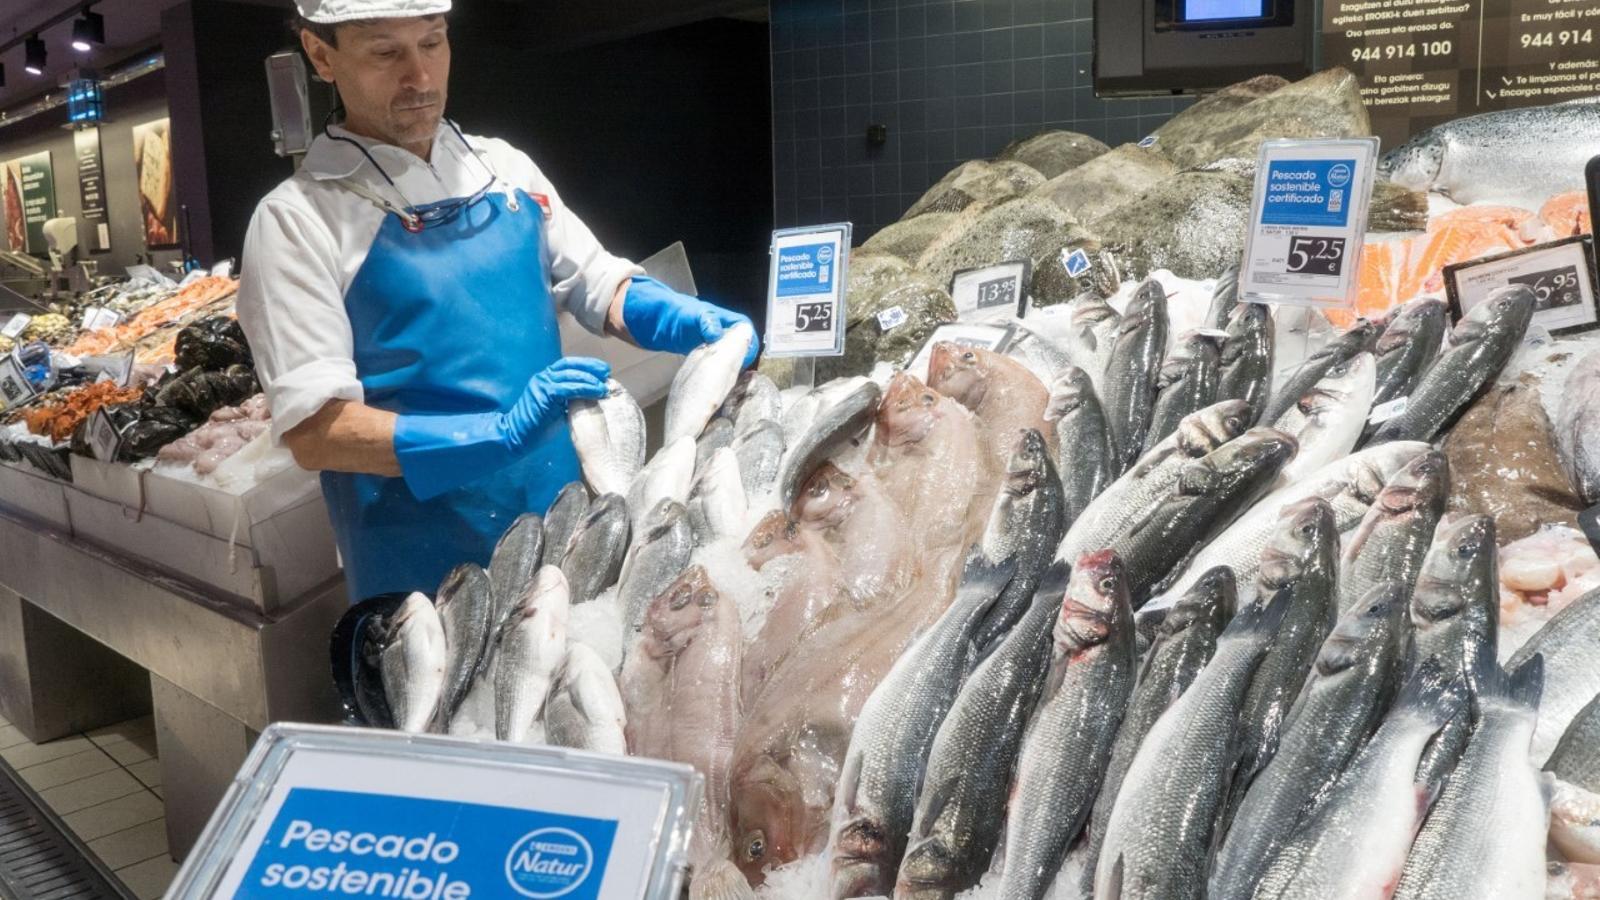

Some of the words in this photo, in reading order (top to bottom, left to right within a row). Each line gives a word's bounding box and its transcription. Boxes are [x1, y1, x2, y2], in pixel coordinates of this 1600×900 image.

[1332, 14, 1363, 25] egiteko
[1365, 10, 1400, 21] EROSKI-k
[1402, 9, 1424, 18] duen
[1426, 3, 1470, 15] zerbitzua?
[1521, 13, 1531, 22] Es
[1533, 12, 1553, 21] muy
[1577, 10, 1584, 19] y
[1346, 29, 1362, 38] Oso
[1364, 27, 1390, 36] erraza
[1392, 25, 1406, 34] eta
[1408, 23, 1437, 32] erosoa
[1439, 21, 1454, 29] da.
[1520, 32, 1553, 48] 944
[1558, 29, 1592, 45] 914
[1351, 46, 1381, 62] 944
[1385, 44, 1416, 59] 914
[1421, 41, 1452, 56] 100
[1557, 60, 1599, 70] además:
[1374, 75, 1387, 83] Eta
[1389, 73, 1424, 84] gainera:
[1516, 76, 1527, 84] Te
[1529, 73, 1576, 84] limpiamos
[1380, 84, 1420, 96] garbitzen
[1421, 82, 1450, 92] dizugu
[1499, 88, 1541, 98] Encargos
[1543, 84, 1593, 95] especiales
[1374, 96, 1409, 105] bereziak
[1272, 170, 1317, 180] Pescado
[1270, 182, 1321, 191] sostenible
[1268, 193, 1324, 203] certificado
[781, 253, 810, 262] Pescado
[1287, 239, 1344, 271] 5,25
[780, 262, 814, 271] sostenible
[1328, 262, 1336, 272] €
[779, 270, 817, 280] certificado
[1533, 272, 1577, 302] 6,95
[796, 304, 832, 331] 5,25
[280, 820, 459, 864] Pescado
[513, 850, 584, 876] Natur
[261, 862, 471, 900] sostenible
